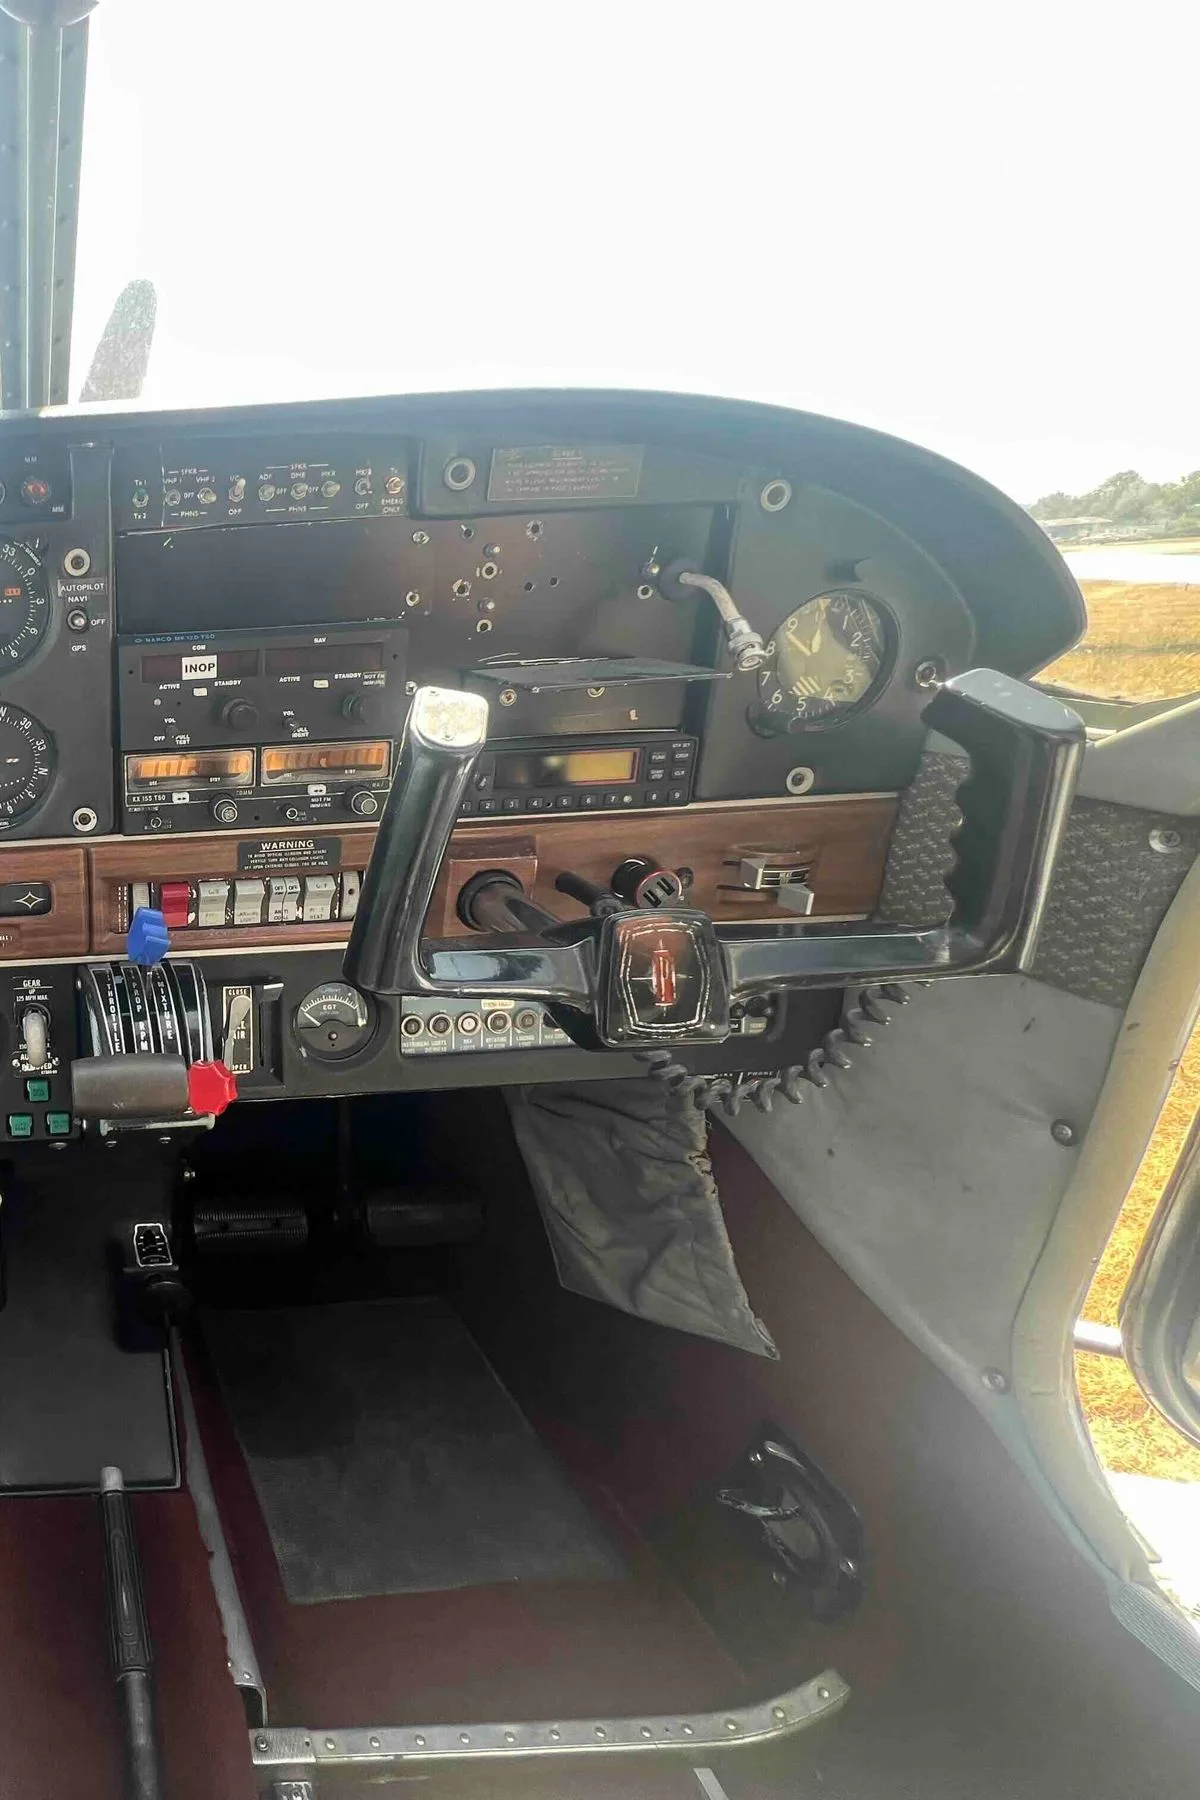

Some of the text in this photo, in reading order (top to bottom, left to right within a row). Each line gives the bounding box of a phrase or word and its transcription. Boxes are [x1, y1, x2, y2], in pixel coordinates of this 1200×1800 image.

[60, 582, 105, 593] AUTOPILOT
[90, 618, 106, 626] OFF
[185, 663, 216, 673] INOP
[261, 840, 314, 851] WARNING
[23, 979, 41, 988] GEAR
[228, 988, 247, 996] CLOSE
[157, 981, 174, 1040] MIXTURE
[106, 983, 121, 1052] THROTTLE
[131, 982, 148, 1051] PROP RPM
